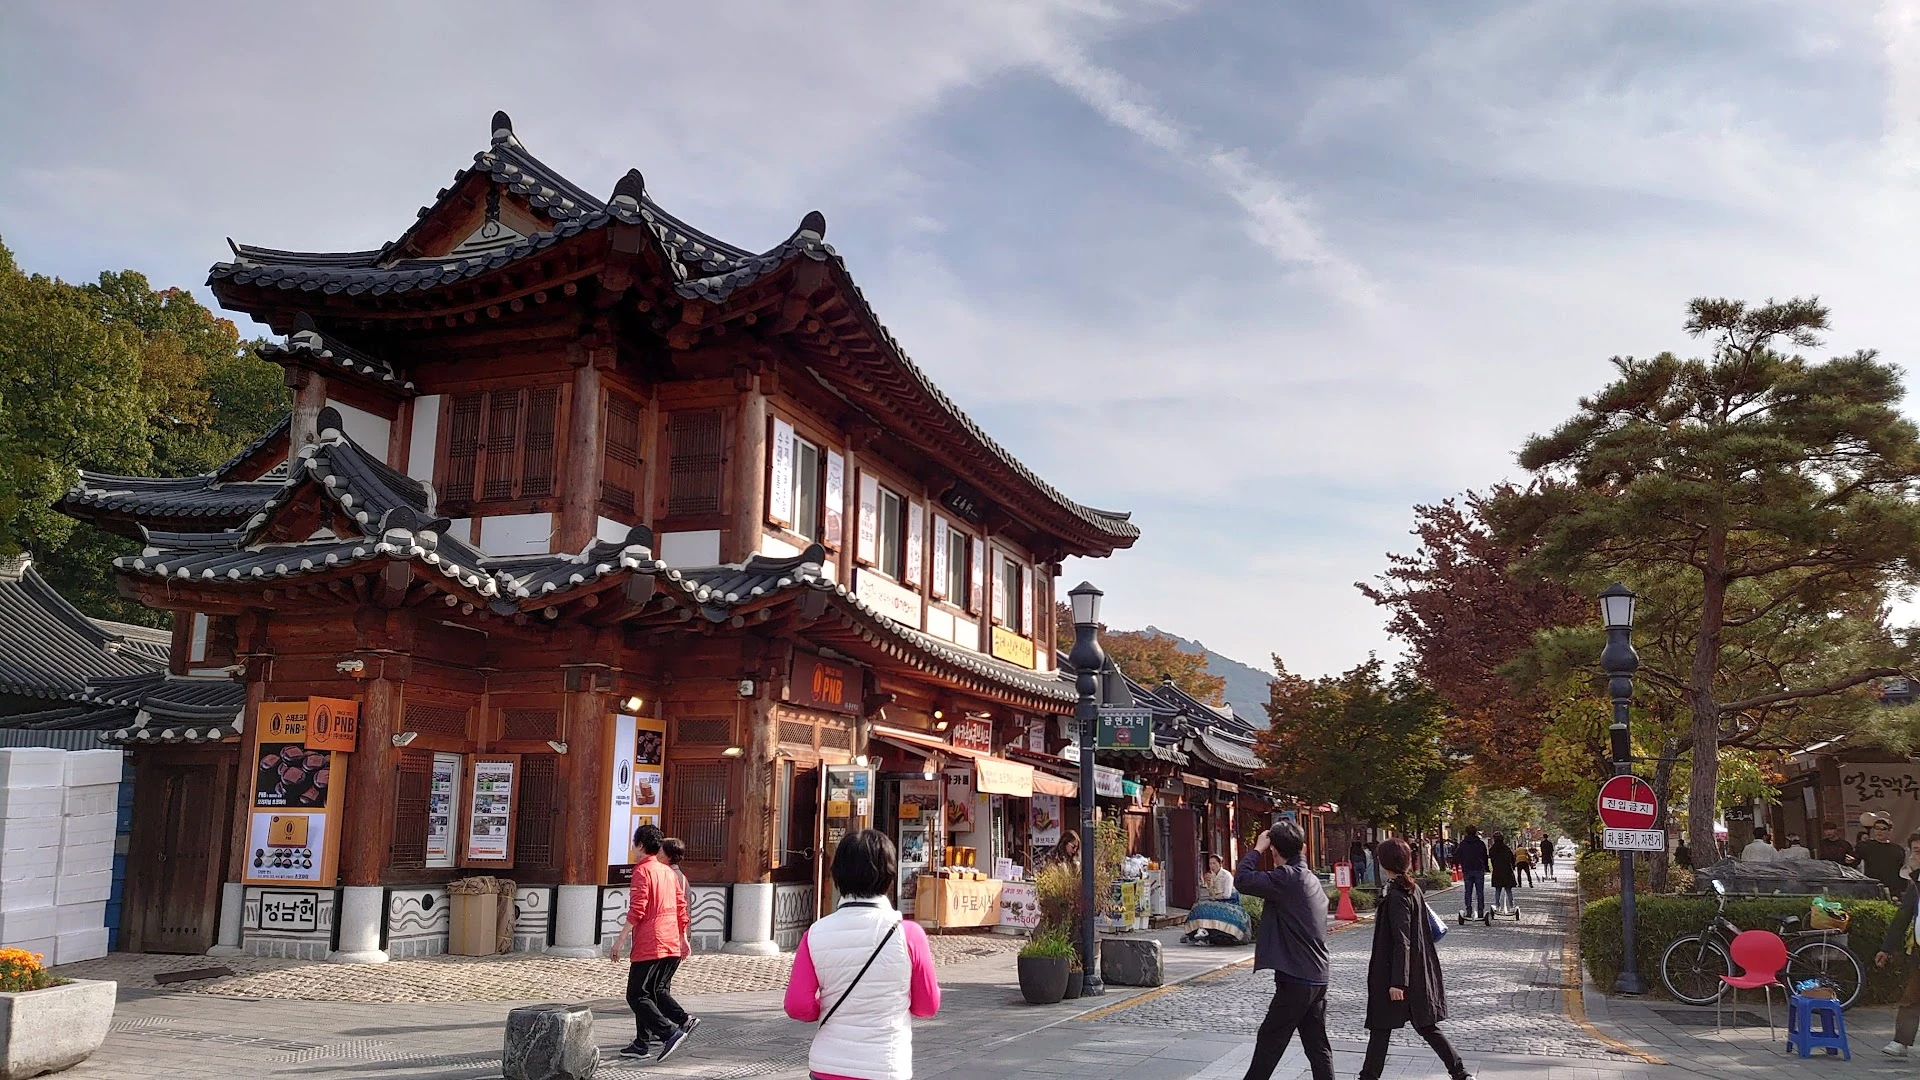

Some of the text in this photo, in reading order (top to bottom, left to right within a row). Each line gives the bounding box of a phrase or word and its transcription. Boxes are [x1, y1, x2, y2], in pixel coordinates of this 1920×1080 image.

[822, 677, 843, 704] PNB
[284, 723, 300, 735] PNB
[334, 717, 355, 732] PNB
[1104, 716, 1144, 726] 금연거리
[1843, 771, 1920, 802] 얼음맥주
[1607, 800, 1649, 813] 진입금지
[265, 899, 313, 922] 정남헌
[961, 894, 994, 913] 무료시식
